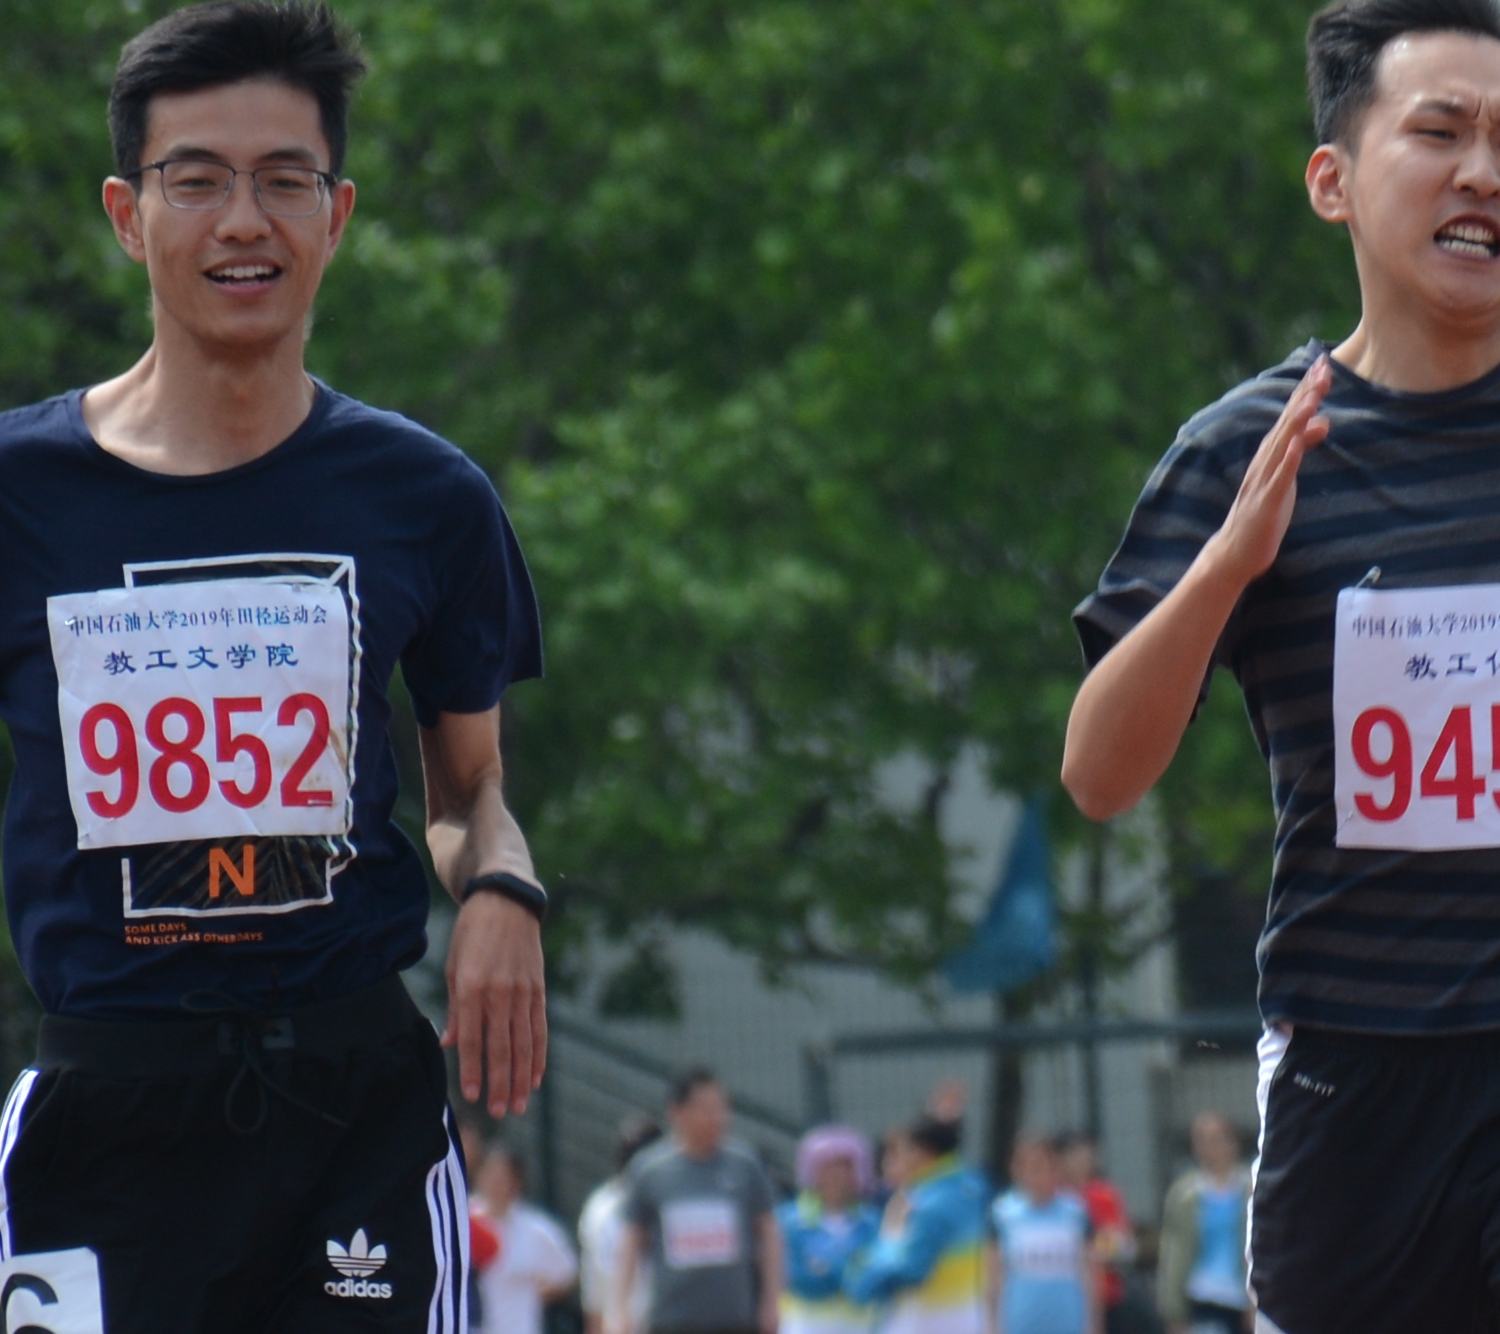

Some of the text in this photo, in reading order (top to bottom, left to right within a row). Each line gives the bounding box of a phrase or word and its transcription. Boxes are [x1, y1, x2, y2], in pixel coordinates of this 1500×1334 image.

[103, 642, 299, 677] 教工文学院
[78, 692, 334, 819] 9852
[208, 844, 255, 898] N
[124, 922, 187, 935] SOME DAYS
[125, 936, 150, 945] AND
[153, 935, 178, 945] KICK
[180, 933, 200, 942] ASS
[323, 1278, 393, 1299] adidas
